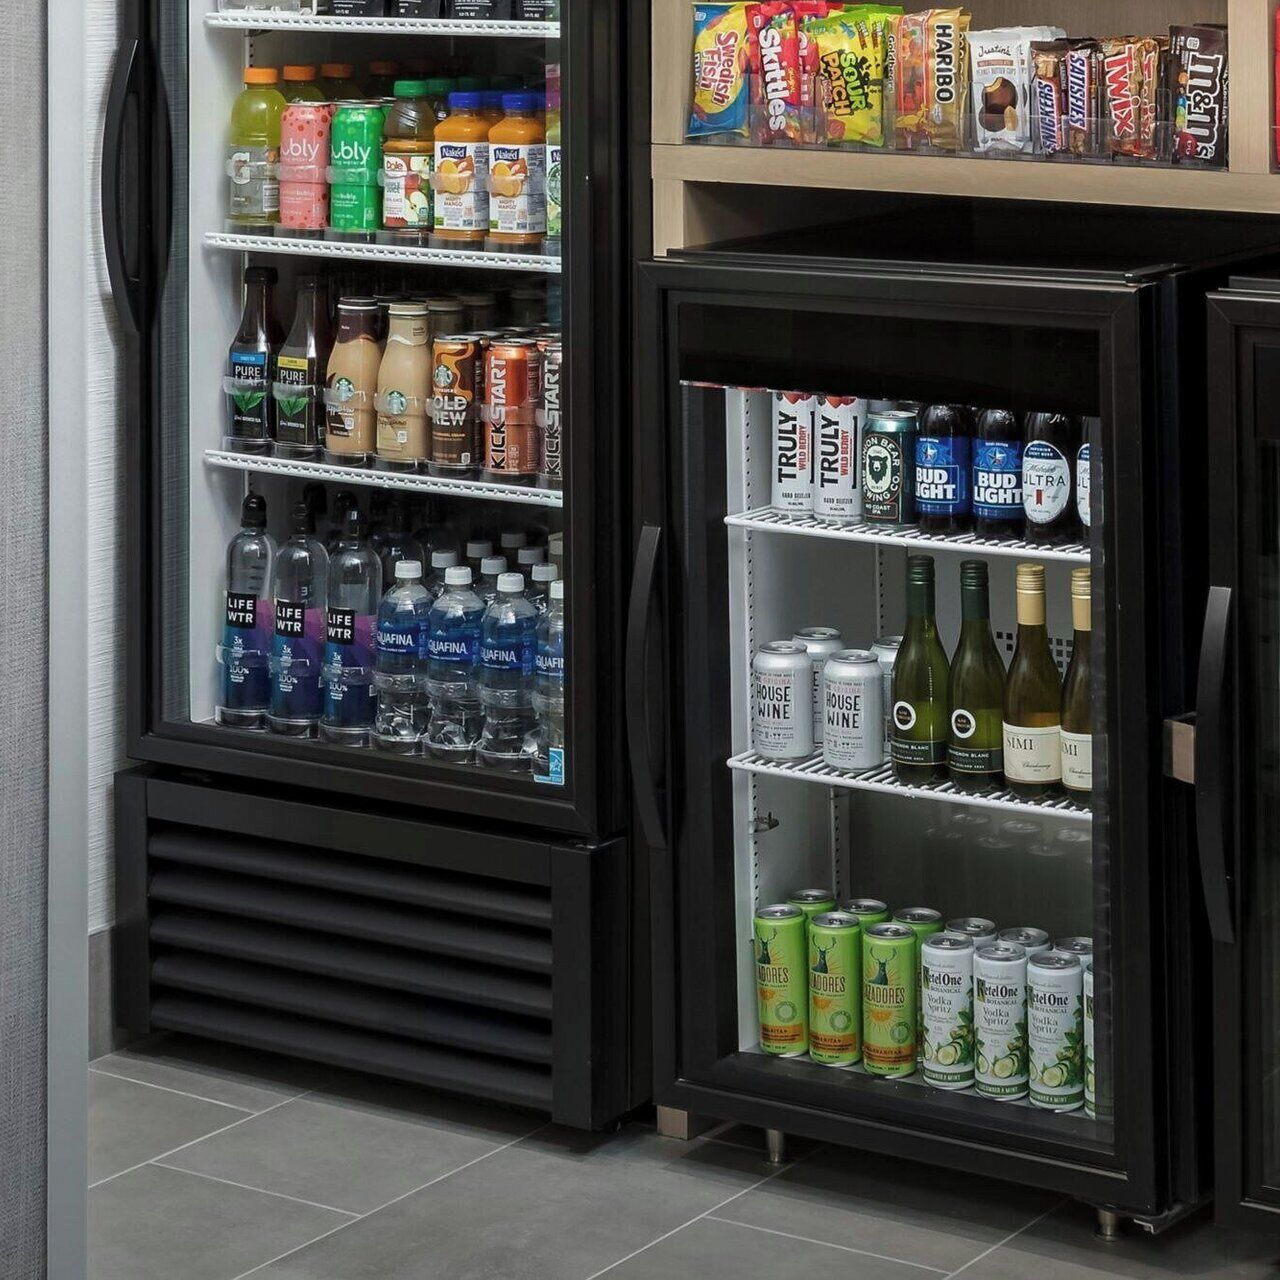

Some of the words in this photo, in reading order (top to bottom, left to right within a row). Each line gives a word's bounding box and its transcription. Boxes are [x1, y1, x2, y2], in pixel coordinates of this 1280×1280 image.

[977, 45, 1012, 58] Justin's
[700, 47, 721, 91] Fish
[711, 30, 739, 107] Swedish
[934, 22, 955, 104] HARIBO
[757, 27, 790, 132] Skittles
[821, 51, 853, 117] PATCH
[839, 51, 867, 111] SOUR
[1069, 51, 1087, 129] SATISFIES
[1106, 43, 1140, 138] TWIX
[1036, 77, 1062, 155] SNICKERS
[441, 147, 466, 158] Naked
[494, 149, 519, 160] Naked
[386, 160, 403, 170] Dole
[235, 365, 261, 377] PURE
[280, 370, 305, 382] PURE
[490, 355, 507, 471] KICKSTART
[544, 359, 561, 476] KICKSTART
[798, 424, 807, 449] BERRY
[841, 429, 850, 454] BERRY
[778, 410, 798, 484] TRULY
[820, 414, 840, 489] TRULY
[880, 437, 901, 467] BEAR
[798, 449, 807, 471] WILD
[841, 454, 850, 477] WILD
[916, 467, 948, 484] BUD
[977, 472, 1017, 488] BUD
[973, 486, 1023, 505] LIGHT
[227, 597, 254, 610] LIFE
[227, 611, 254, 623] WTR
[276, 606, 302, 619] LIFE
[328, 613, 352, 626] LIFE
[276, 619, 302, 632] WTR
[328, 627, 352, 640] WTR
[756, 683, 791, 703] HOUSE
[826, 691, 861, 712] HOUSE
[757, 702, 790, 720] WINE
[826, 710, 860, 729] WINE
[1006, 736, 1034, 751] SIMI
[942, 973, 963, 986] One
[1000, 985, 1018, 997] One
[926, 994, 952, 1006] Vodka
[1047, 993, 1070, 1007] One
[927, 1003, 952, 1015] Spritz
[982, 1006, 1010, 1018] Vodka
[983, 1015, 1009, 1026] Spritz
[1031, 1013, 1058, 1026] Vodka
[1032, 1022, 1058, 1035] Spritz
